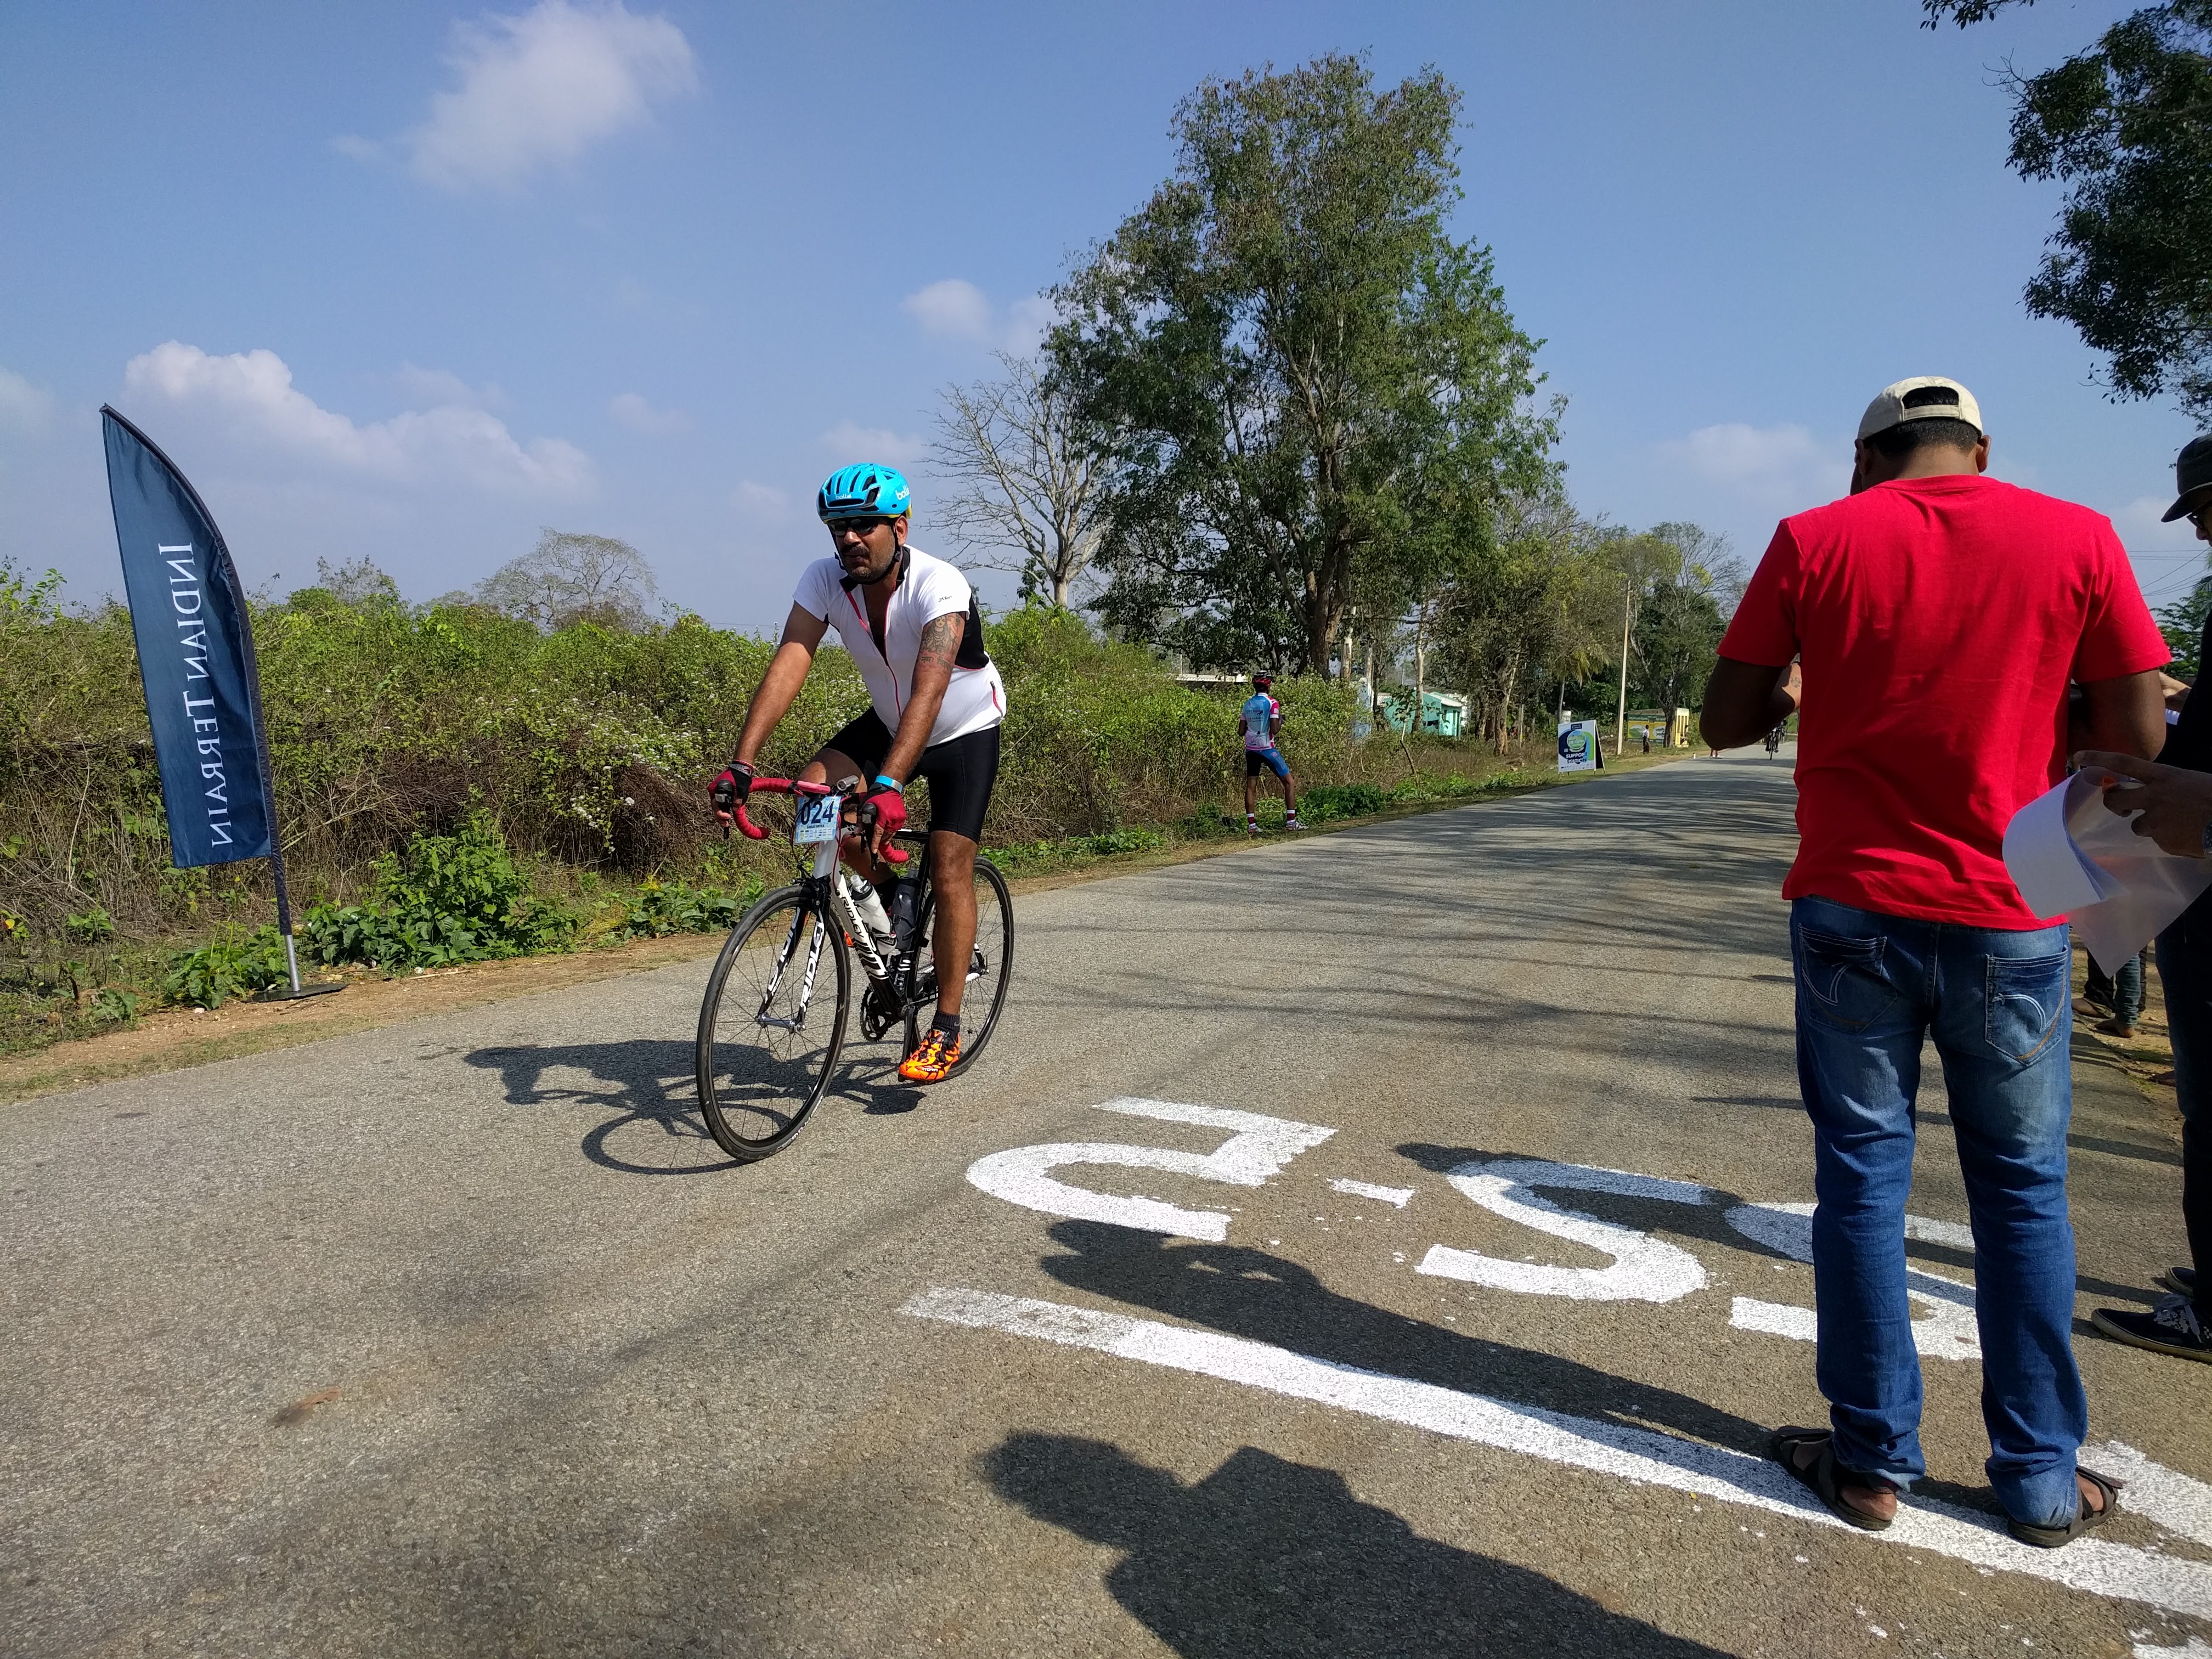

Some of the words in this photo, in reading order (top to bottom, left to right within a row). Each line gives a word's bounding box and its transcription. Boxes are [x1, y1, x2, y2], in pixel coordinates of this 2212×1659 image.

[801, 800, 834, 825] 024
[842, 896, 865, 938] RIDLEY
[800, 907, 825, 1012] RIDLEY
